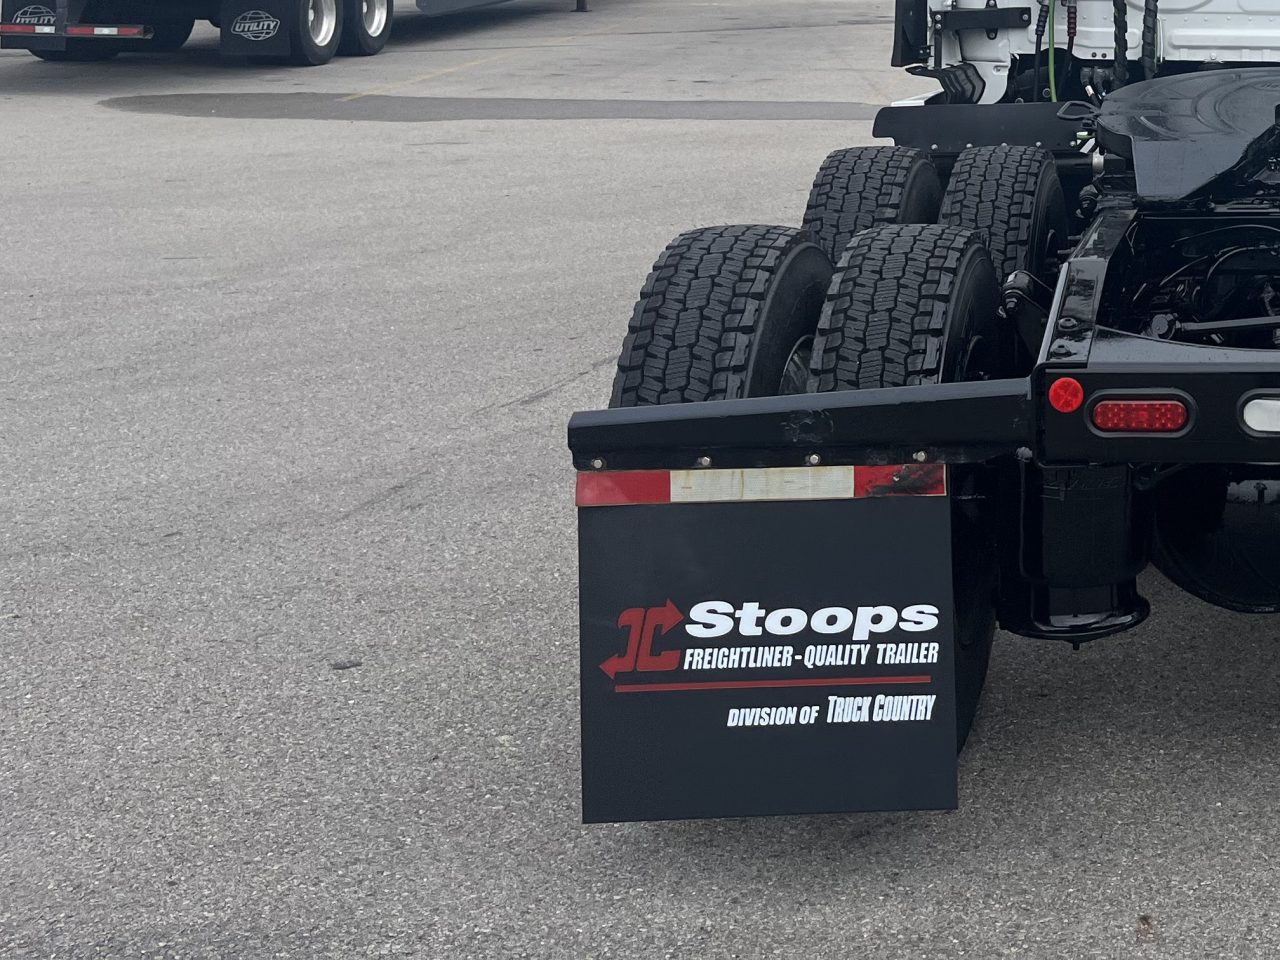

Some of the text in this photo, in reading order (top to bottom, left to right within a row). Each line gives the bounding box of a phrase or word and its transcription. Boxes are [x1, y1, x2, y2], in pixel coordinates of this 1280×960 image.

[235, 21, 276, 32] UTILITY
[685, 601, 939, 640] Stoops
[876, 642, 939, 665] TRAILER
[727, 695, 937, 727] DIVISION OF TRUCK COUNTRY
